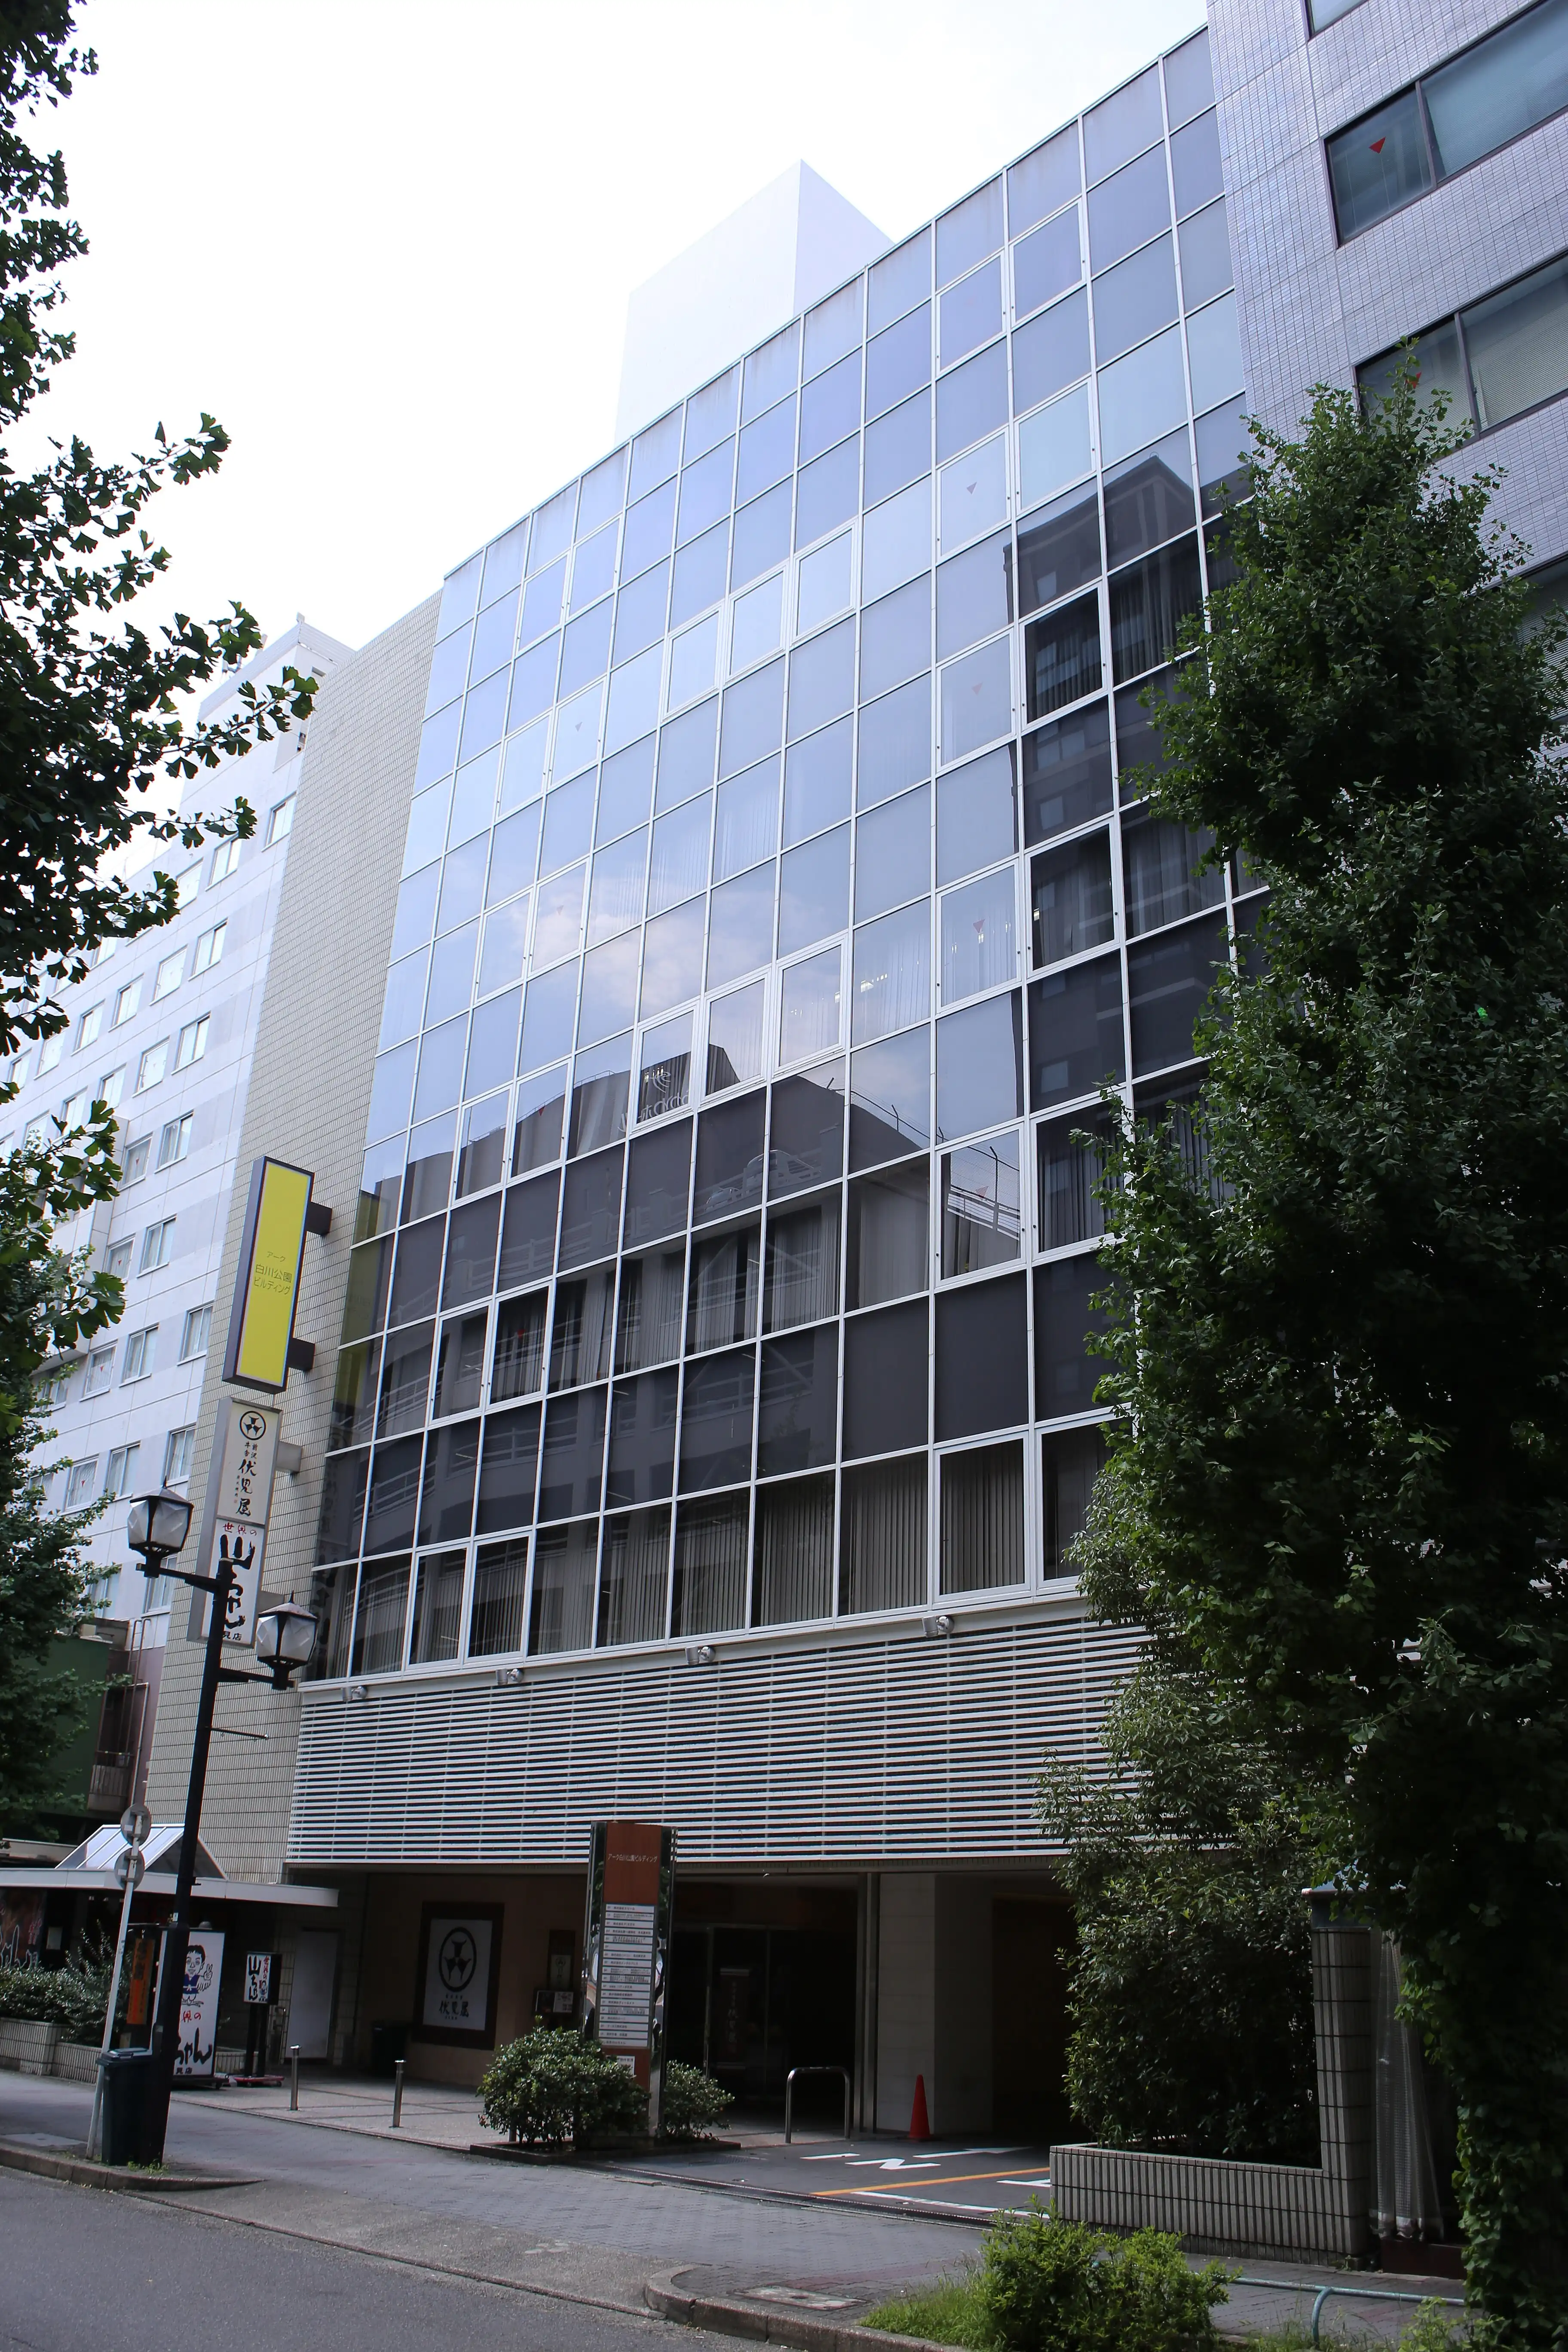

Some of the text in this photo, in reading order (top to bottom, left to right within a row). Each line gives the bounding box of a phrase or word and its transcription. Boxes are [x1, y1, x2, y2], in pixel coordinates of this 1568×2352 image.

[267, 1251, 286, 1262] アーク
[256, 1264, 292, 1283] 白川公園
[254, 1276, 291, 1295] ビルディング
[236, 1458, 257, 1517] 伏見屋
[223, 1522, 257, 1536] 世界の
[223, 1631, 242, 1641] 見店
[182, 2010, 201, 2023] 界の
